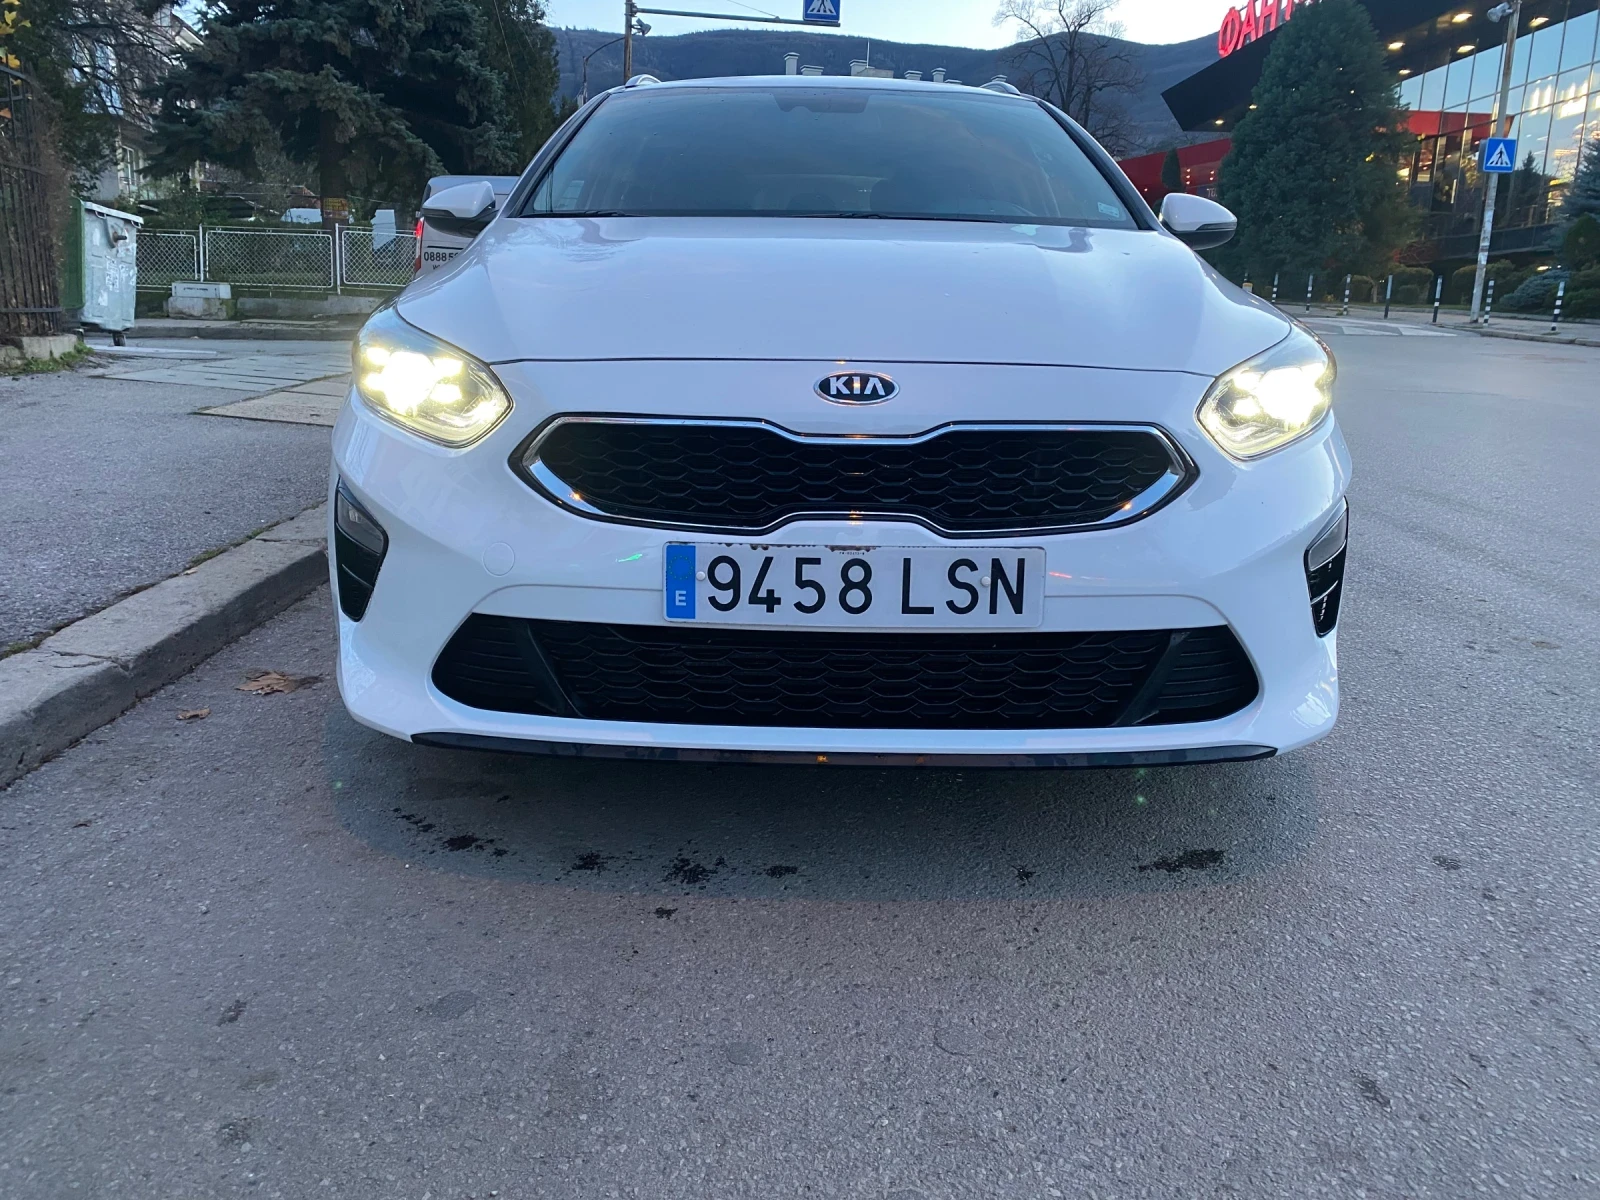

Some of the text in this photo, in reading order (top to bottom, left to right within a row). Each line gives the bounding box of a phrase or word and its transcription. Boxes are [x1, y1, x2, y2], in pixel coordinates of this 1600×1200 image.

[828, 376, 886, 396] KIA
[707, 555, 1026, 615] 9458 LSN
[675, 590, 687, 606] E
